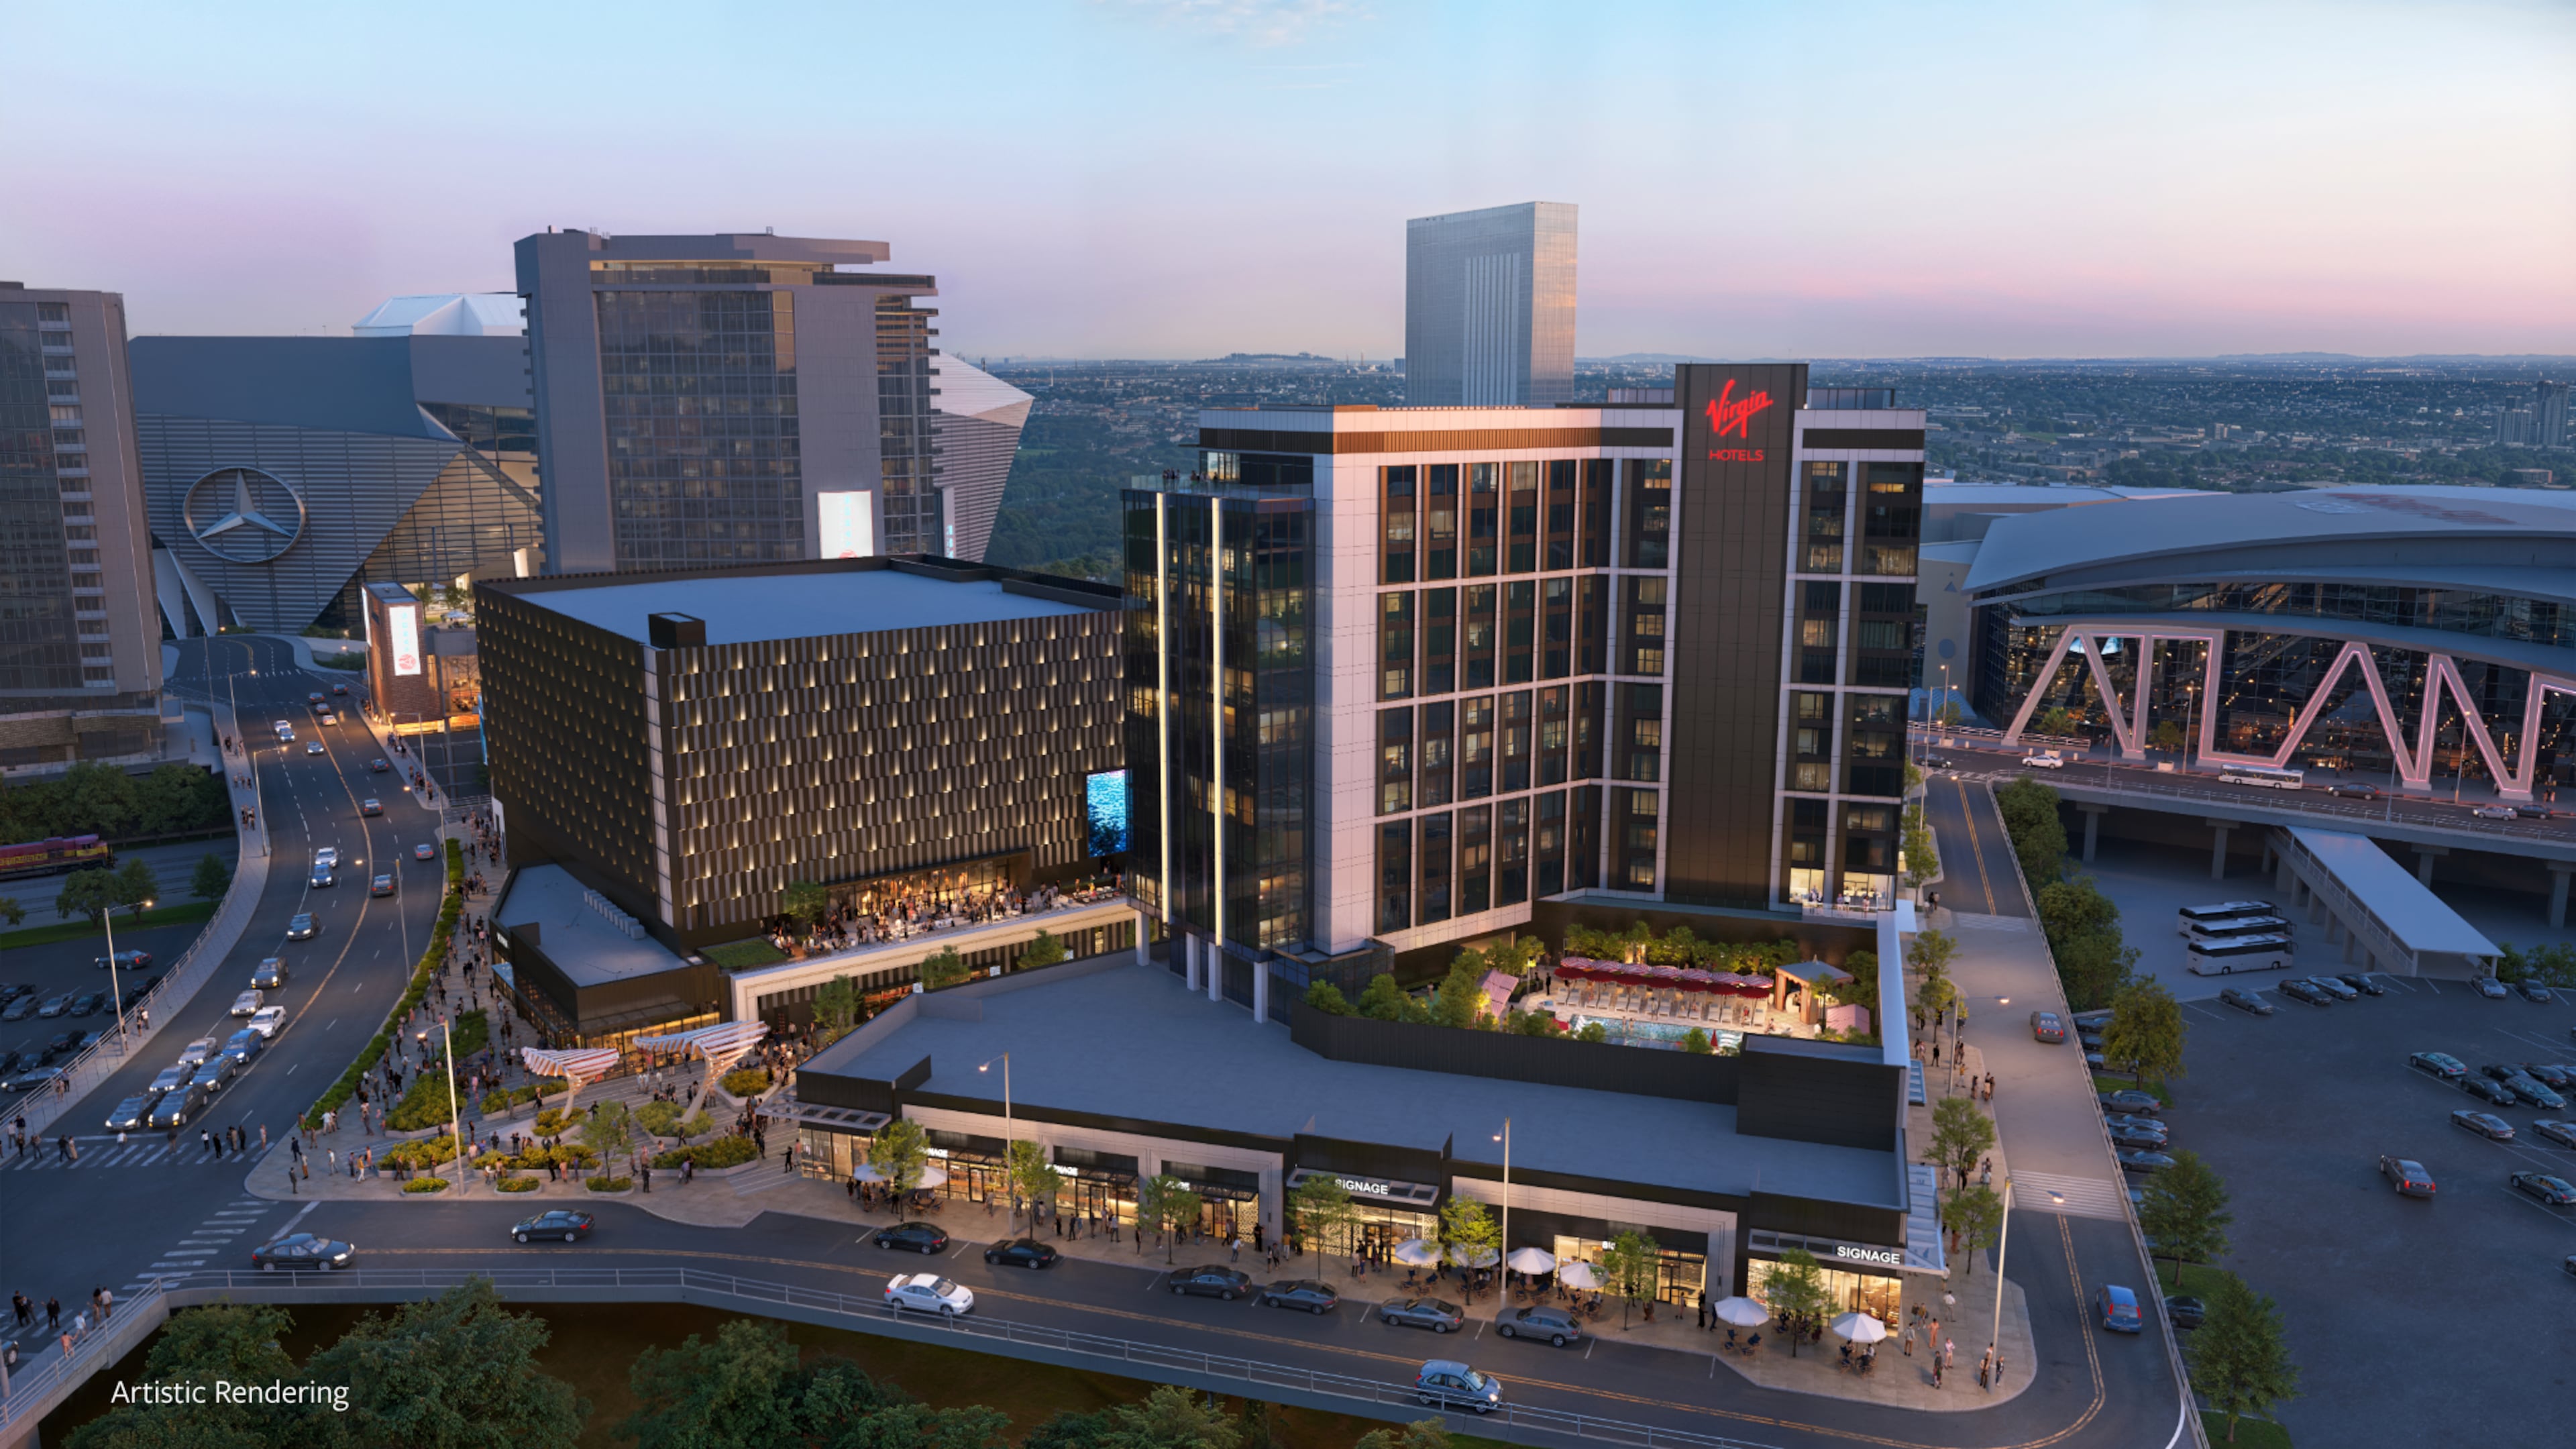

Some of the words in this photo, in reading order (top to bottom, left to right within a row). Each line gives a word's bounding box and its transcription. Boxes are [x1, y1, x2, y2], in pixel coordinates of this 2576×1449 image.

[1705, 379, 1773, 438] Virgin
[1709, 449, 1764, 461] HOTELS
[2001, 624, 2576, 800] ATLAN
[1335, 1178, 1389, 1194] SIGNAGE
[1837, 1246, 1900, 1265] SIGNAGE
